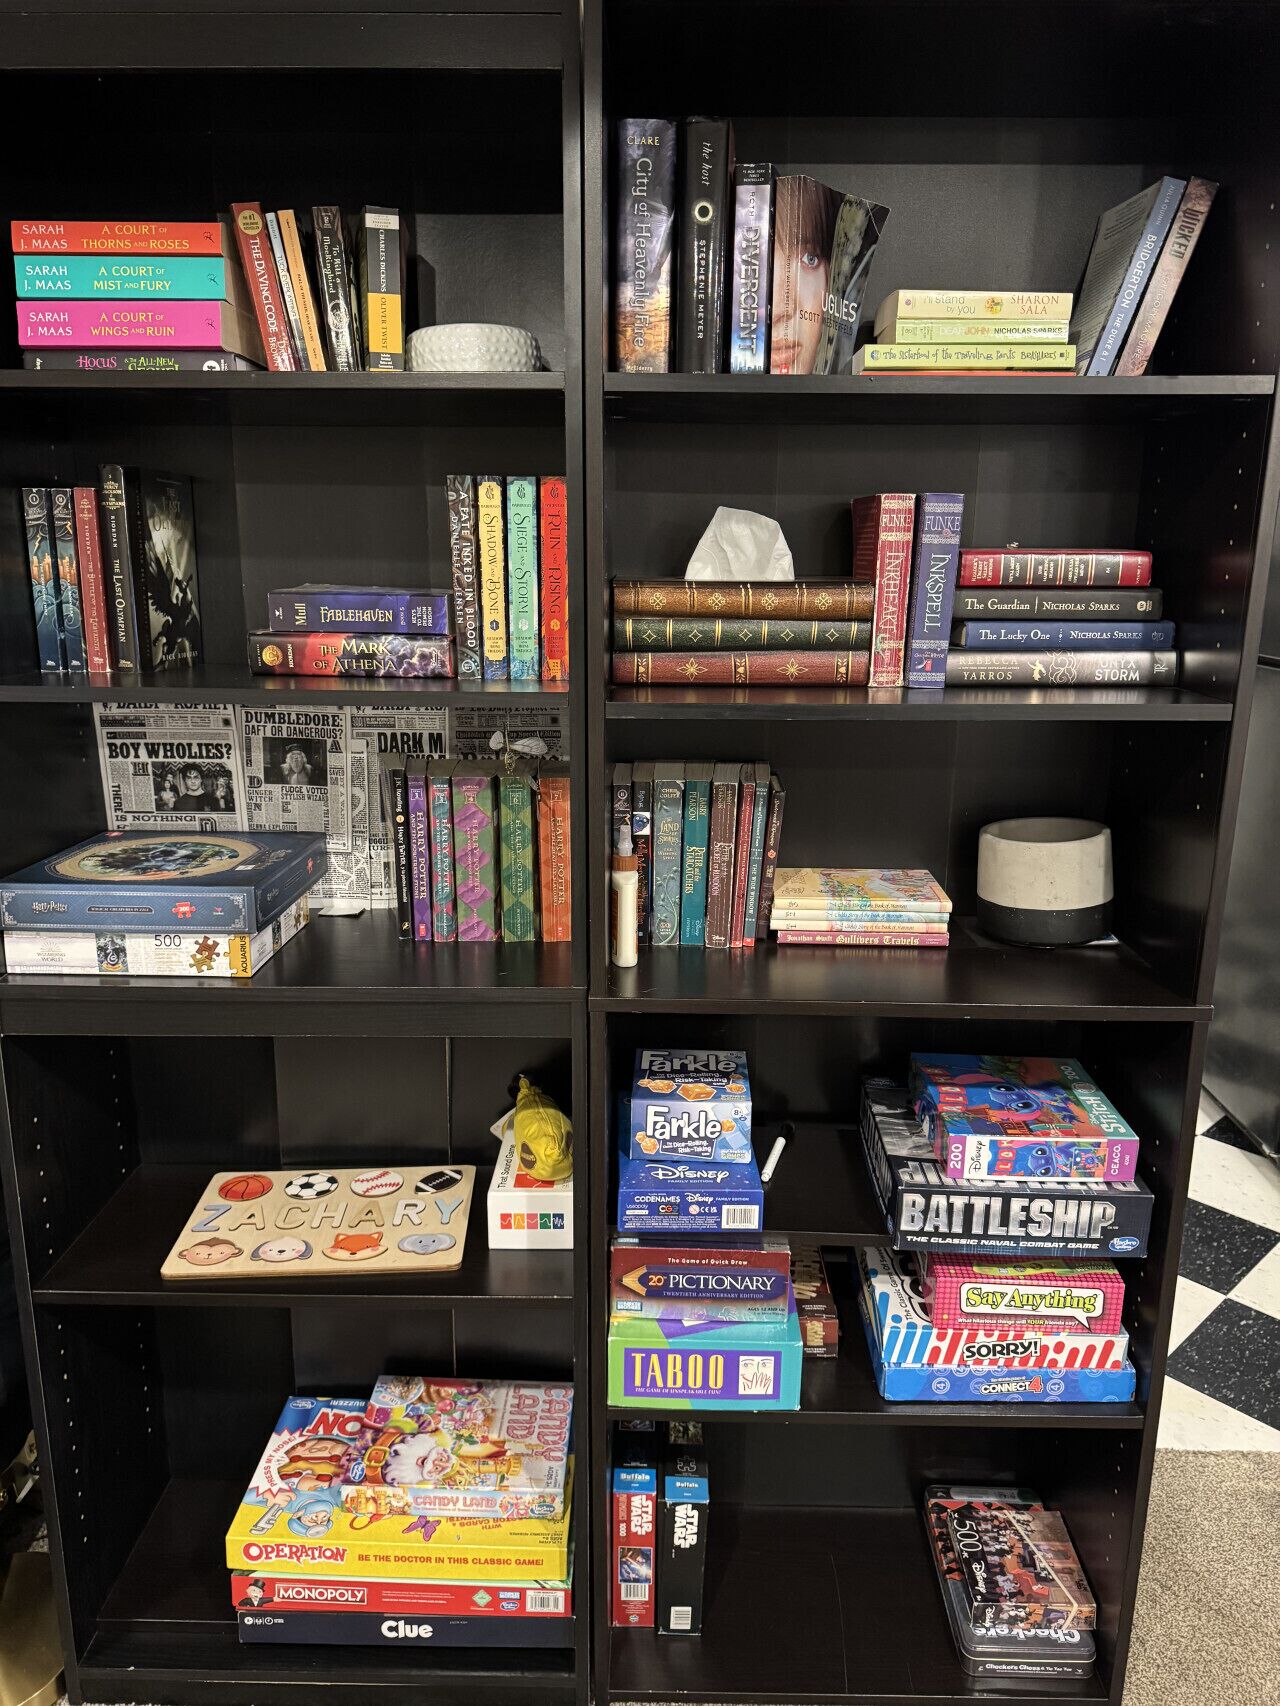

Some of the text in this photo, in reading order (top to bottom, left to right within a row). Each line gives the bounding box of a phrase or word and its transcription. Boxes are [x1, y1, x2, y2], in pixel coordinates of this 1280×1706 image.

[627, 136, 660, 146] CLARE
[22, 224, 64, 235] SARAH
[102, 225, 111, 235] A
[115, 225, 157, 235] COURT
[1171, 207, 1204, 260] WICKED
[20, 239, 68, 250] J. MAAS
[81, 239, 132, 249] THORNS
[150, 239, 190, 249] ROSES
[379, 229, 387, 261] CHARLES
[26, 266, 68, 276] SARAH
[99, 266, 108, 276] A
[112, 266, 154, 276] COURT
[323, 236, 336, 294] Mockingbird
[698, 239, 707, 300] STEPHENIE
[1121, 233, 1158, 310] BRIDGERTON
[24, 281, 71, 291] J. MAAS
[93, 281, 122, 291] MIST
[140, 281, 171, 291] FURY
[738, 224, 761, 354] DIVERGENT
[821, 291, 858, 322] UGLIES
[1010, 295, 1060, 305] SHARON
[29, 312, 68, 322] SARAH
[100, 312, 108, 322] A
[113, 312, 153, 322] COURT
[380, 297, 388, 326] OLIVER
[800, 309, 821, 323] SCOTT
[1019, 305, 1048, 315] SALA
[27, 327, 73, 337] J. MAAS
[91, 327, 129, 337] WINGS
[146, 327, 175, 337] RUIN
[994, 326, 1063, 335] NICHOLAS SPARKS
[881, 515, 912, 527] FUNKE
[924, 515, 961, 531] FUNKE
[459, 491, 475, 648] A FATE INKED IN BLOOD
[879, 549, 906, 634] INKHEART
[923, 552, 952, 634] INKSPELL
[965, 598, 1030, 610] The Guardian
[1043, 601, 1120, 611] NICHOLAS SPARKS
[320, 606, 393, 623] FABLEHAVEN
[979, 629, 1050, 642] The Lucky One
[1070, 630, 1143, 639] NICHOLAS SPARKS
[320, 638, 392, 656] THE MARK
[313, 658, 396, 673] OF ATHENA
[959, 656, 1019, 666] REBECCA
[1101, 656, 1136, 669] ONYX
[963, 671, 1013, 681] YARROS
[1095, 669, 1140, 682] STORM
[244, 711, 343, 727] DUMBLEDORE:
[245, 725, 343, 740] DAFT OR DANGEROUS?
[281, 786, 329, 795] FUDGE VOTED
[248, 795, 274, 803] WITCH
[556, 817, 566, 904] HARRY POTTER
[154, 934, 182, 947] 500
[786, 934, 833, 942] Jonathan Swift
[836, 934, 919, 946] Gullivers Travels
[240, 935, 248, 974] AQUARIUS
[641, 1050, 738, 1072] Farkle
[646, 1104, 722, 1140] Farkle
[949, 1143, 963, 1170] 200
[968, 1139, 987, 1174] Disney
[1111, 1143, 1121, 1175] CEACO
[645, 1164, 730, 1184] Disney
[634, 1195, 681, 1203] CODENAMES
[191, 1197, 464, 1233] ZACHARY
[900, 1192, 1117, 1239] BATTLESHIP
[905, 1235, 1100, 1249] THE CLASSIC NAVAL COMBAT GAME
[669, 1274, 776, 1292] PICTIONARY
[966, 1286, 1097, 1312] Say Anything
[964, 1340, 1040, 1359] SORRY!
[631, 1352, 725, 1389] TABOO
[981, 1382, 1030, 1394] CONNECT
[1029, 1376, 1043, 1393] 4
[506, 1383, 542, 1441] LAND
[540, 1384, 576, 1464] CANDY
[619, 1472, 650, 1481] Buffalo
[413, 1495, 498, 1508] CANDY LAND
[630, 1494, 641, 1536] WARS
[640, 1494, 653, 1535] STAR
[673, 1504, 687, 1549] WARS
[686, 1504, 699, 1549] STAR
[954, 1520, 982, 1553] 500
[242, 1542, 347, 1564] OPERATION
[358, 1554, 544, 1567] BE THE DOCTOR IN THIS CLASSIC GAME!
[278, 1587, 364, 1602] MONOPOLY
[381, 1620, 434, 1639] Clue
